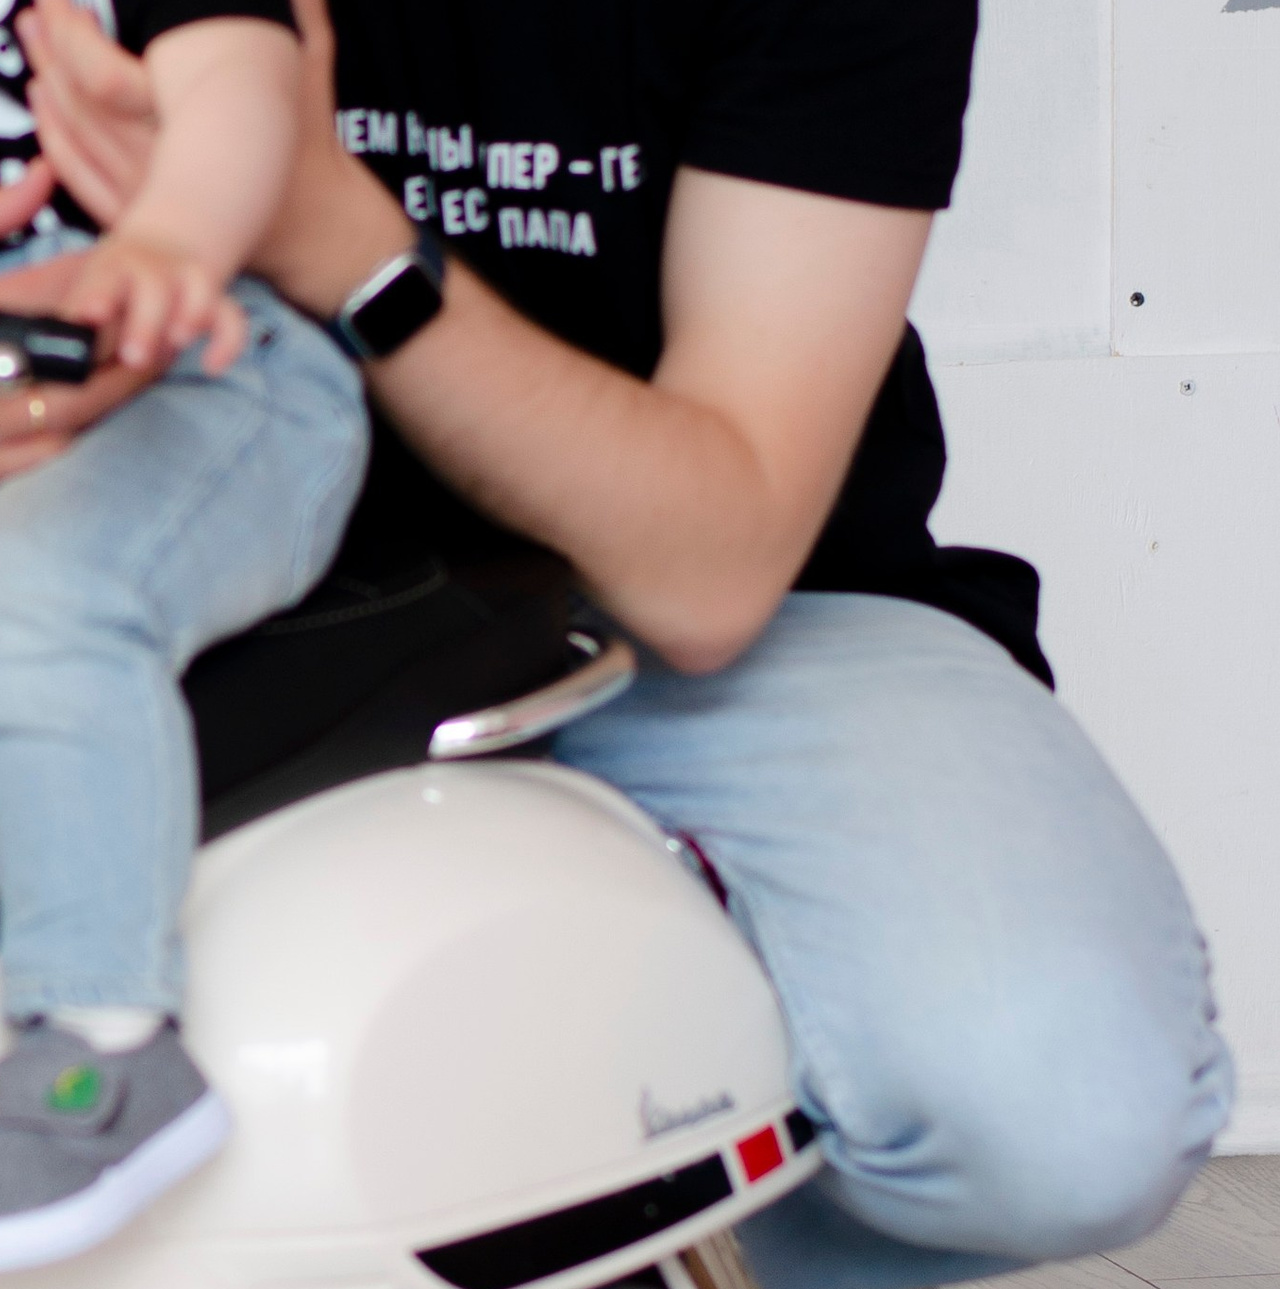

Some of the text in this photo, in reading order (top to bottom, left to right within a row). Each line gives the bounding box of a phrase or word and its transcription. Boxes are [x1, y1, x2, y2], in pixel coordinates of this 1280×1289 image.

[479, 142, 559, 190] ПЕР
[599, 143, 643, 193] ГЕ
[497, 206, 597, 257] ПАПА
